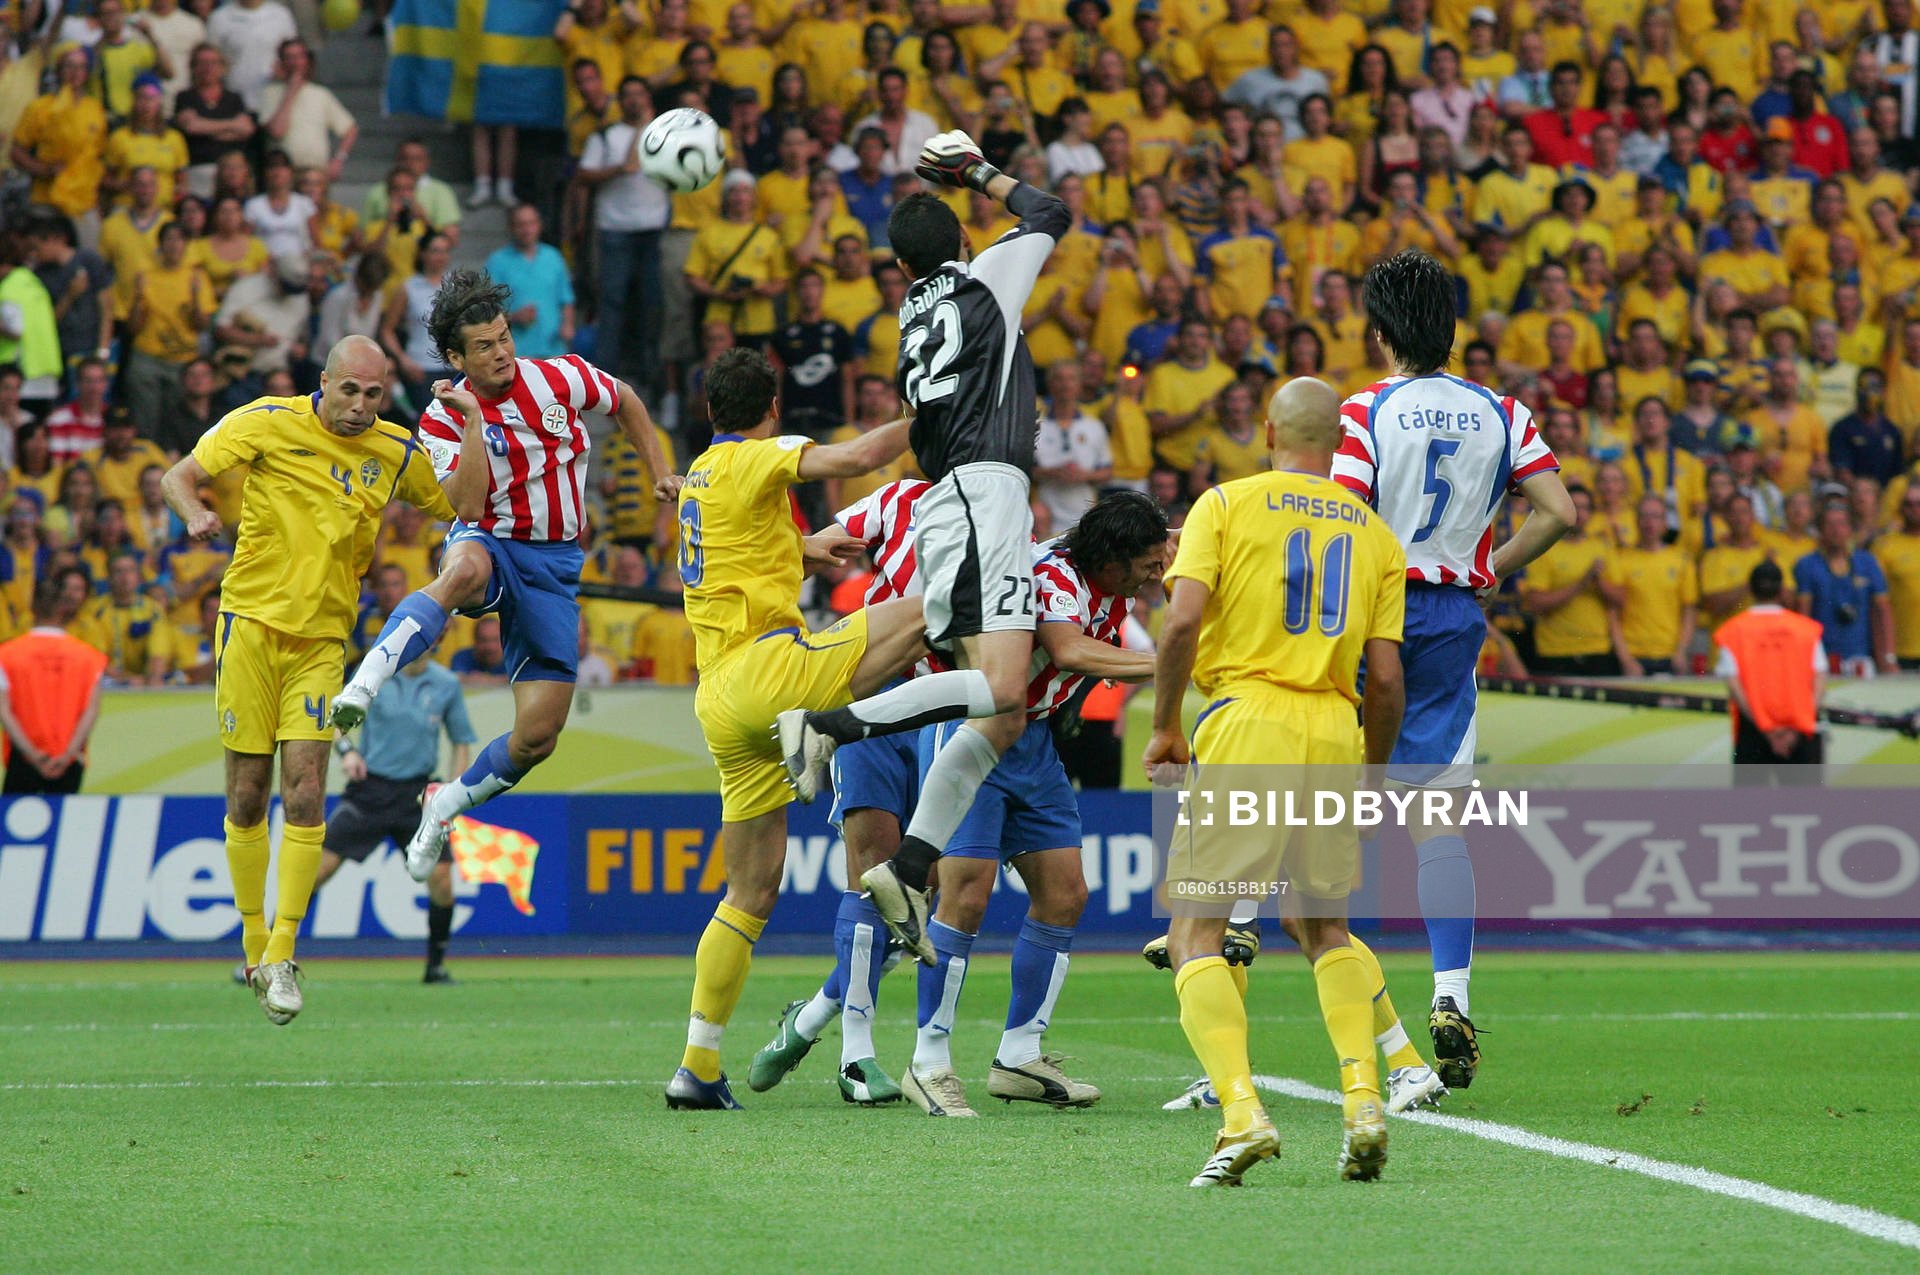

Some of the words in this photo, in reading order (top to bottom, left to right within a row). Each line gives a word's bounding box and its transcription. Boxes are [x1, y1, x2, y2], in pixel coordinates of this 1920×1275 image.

[901, 300, 963, 410] 22
[1398, 404, 1481, 431] cáceres
[486, 424, 509, 457] 8
[330, 462, 352, 496] 4
[1411, 438, 1464, 544] 5
[1267, 492, 1367, 527] LARSSON
[996, 575, 1033, 616] 22
[1282, 527, 1352, 637] 11
[304, 693, 325, 731] 4
